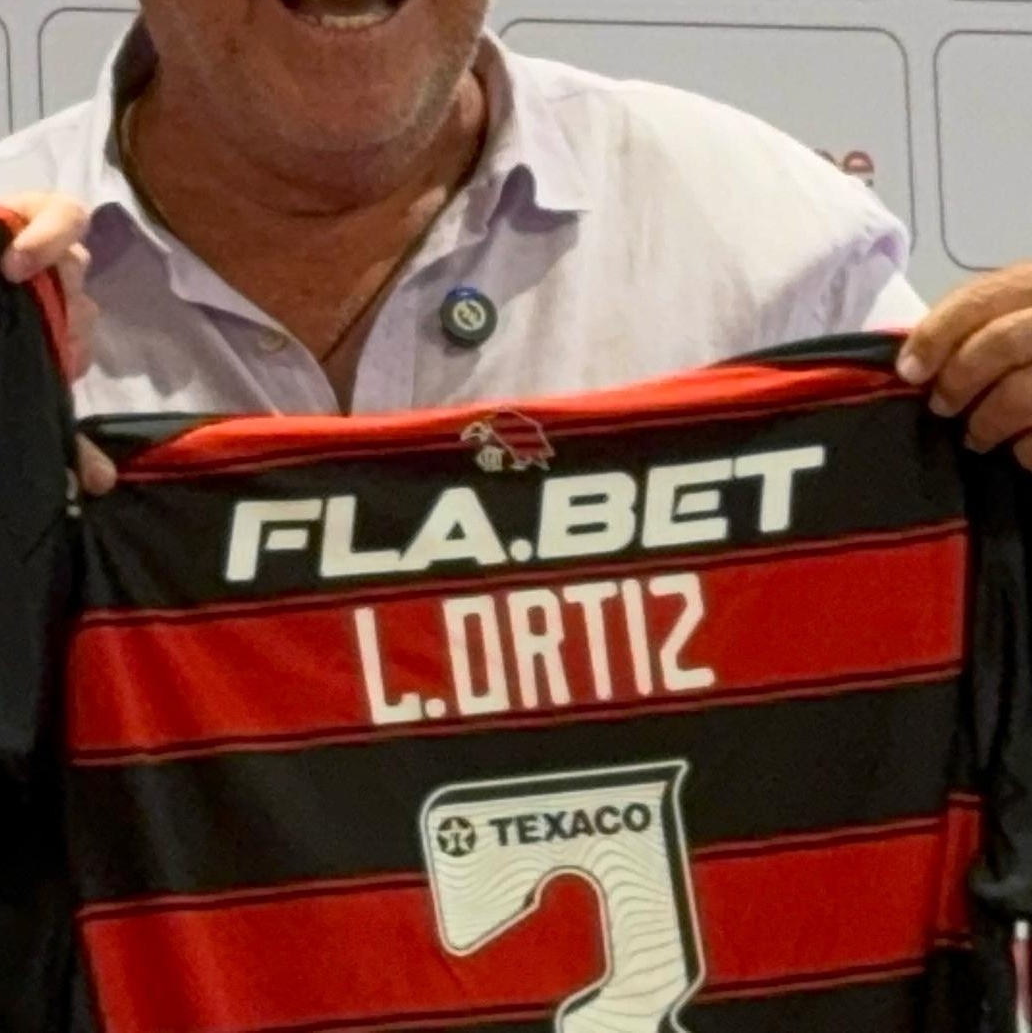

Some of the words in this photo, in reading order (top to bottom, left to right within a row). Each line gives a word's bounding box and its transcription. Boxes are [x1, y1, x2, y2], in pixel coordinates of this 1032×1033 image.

[225, 445, 826, 582] FLA.BET
[355, 572, 715, 725] L.ORTIZ
[488, 802, 651, 847] TEXACO
